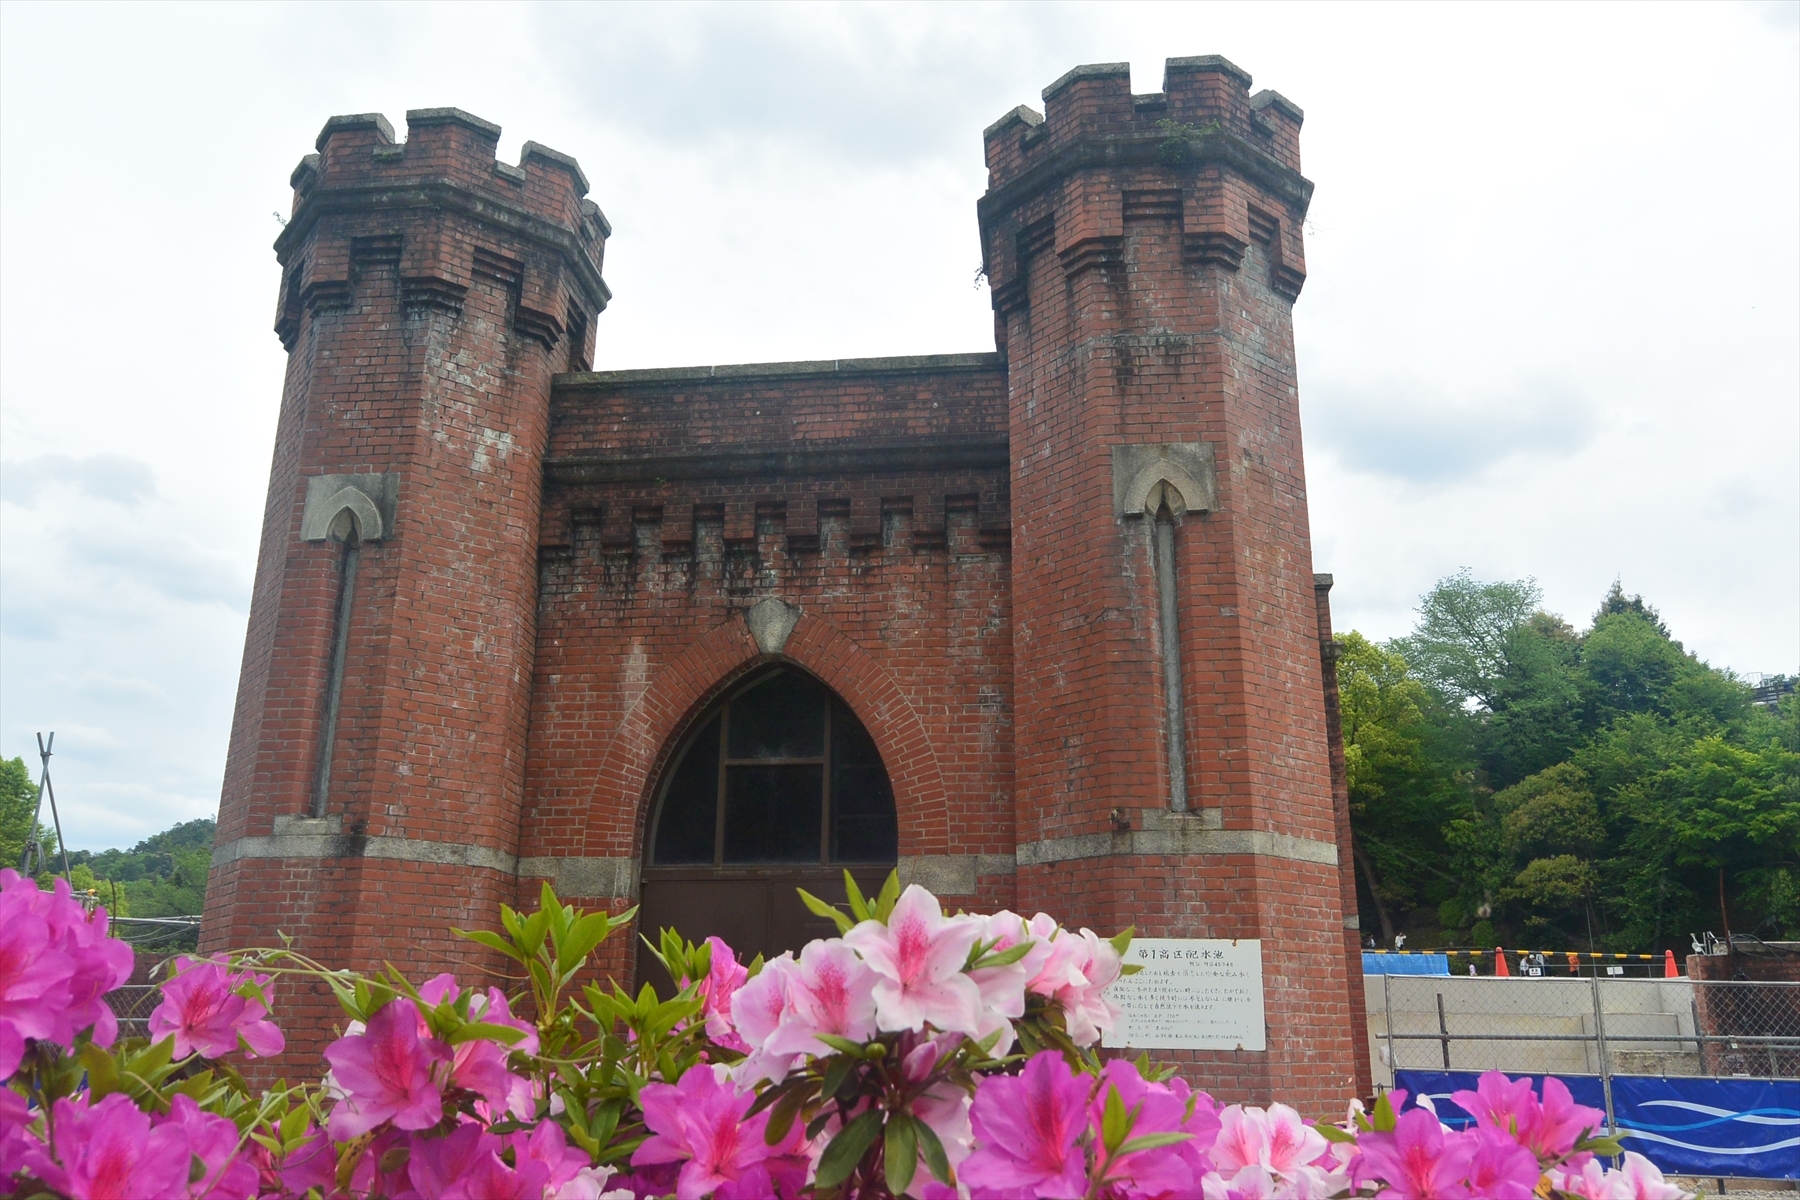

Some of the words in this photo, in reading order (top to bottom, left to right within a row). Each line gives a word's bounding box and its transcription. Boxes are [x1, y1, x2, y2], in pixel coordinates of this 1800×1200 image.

[1138, 949, 1224, 960] 第1高区配水池
